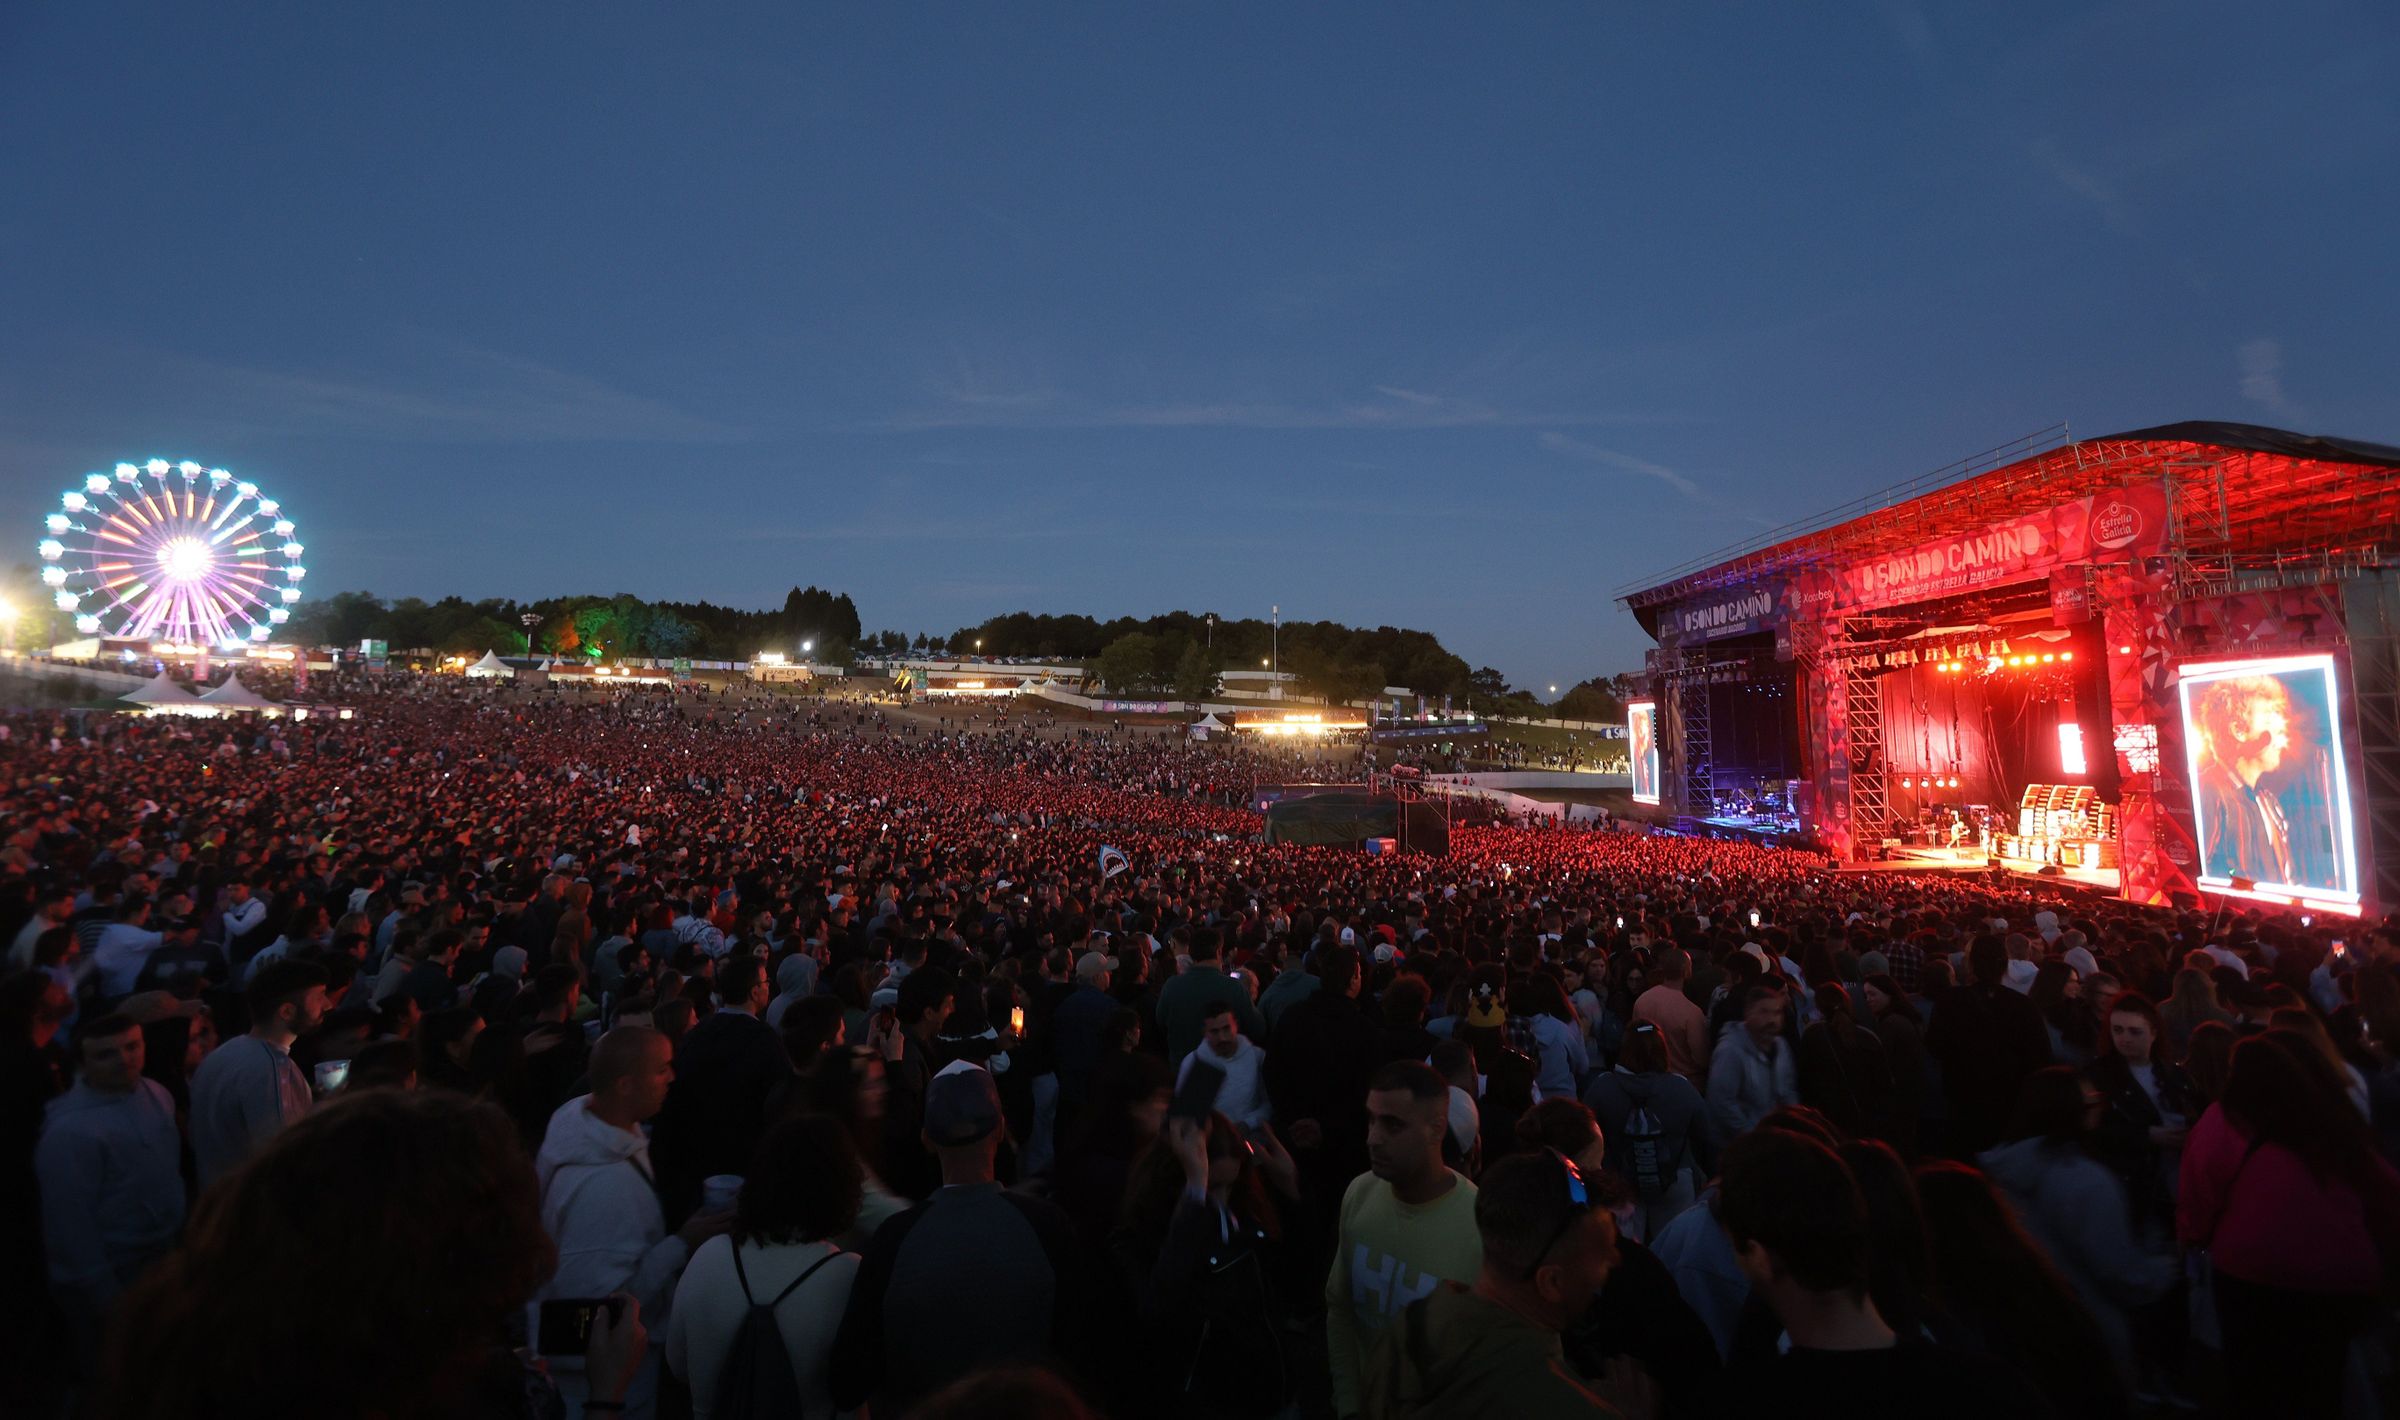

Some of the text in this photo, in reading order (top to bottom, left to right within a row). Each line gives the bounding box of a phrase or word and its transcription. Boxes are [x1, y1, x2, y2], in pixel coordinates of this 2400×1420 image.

[2100, 514, 2132, 529] Estrella
[2101, 525, 2132, 539] Galicia
[1862, 565, 1874, 591] O
[1876, 559, 1915, 589] SON
[1916, 549, 1944, 580] DO
[1930, 574, 1968, 590] ESTRELLA
[1968, 567, 2005, 584] GALICIA
[1685, 613, 1691, 631] O
[1692, 607, 1712, 631] SON
[1713, 605, 1727, 626] DO
[1727, 589, 1772, 622] CAMIÑO
